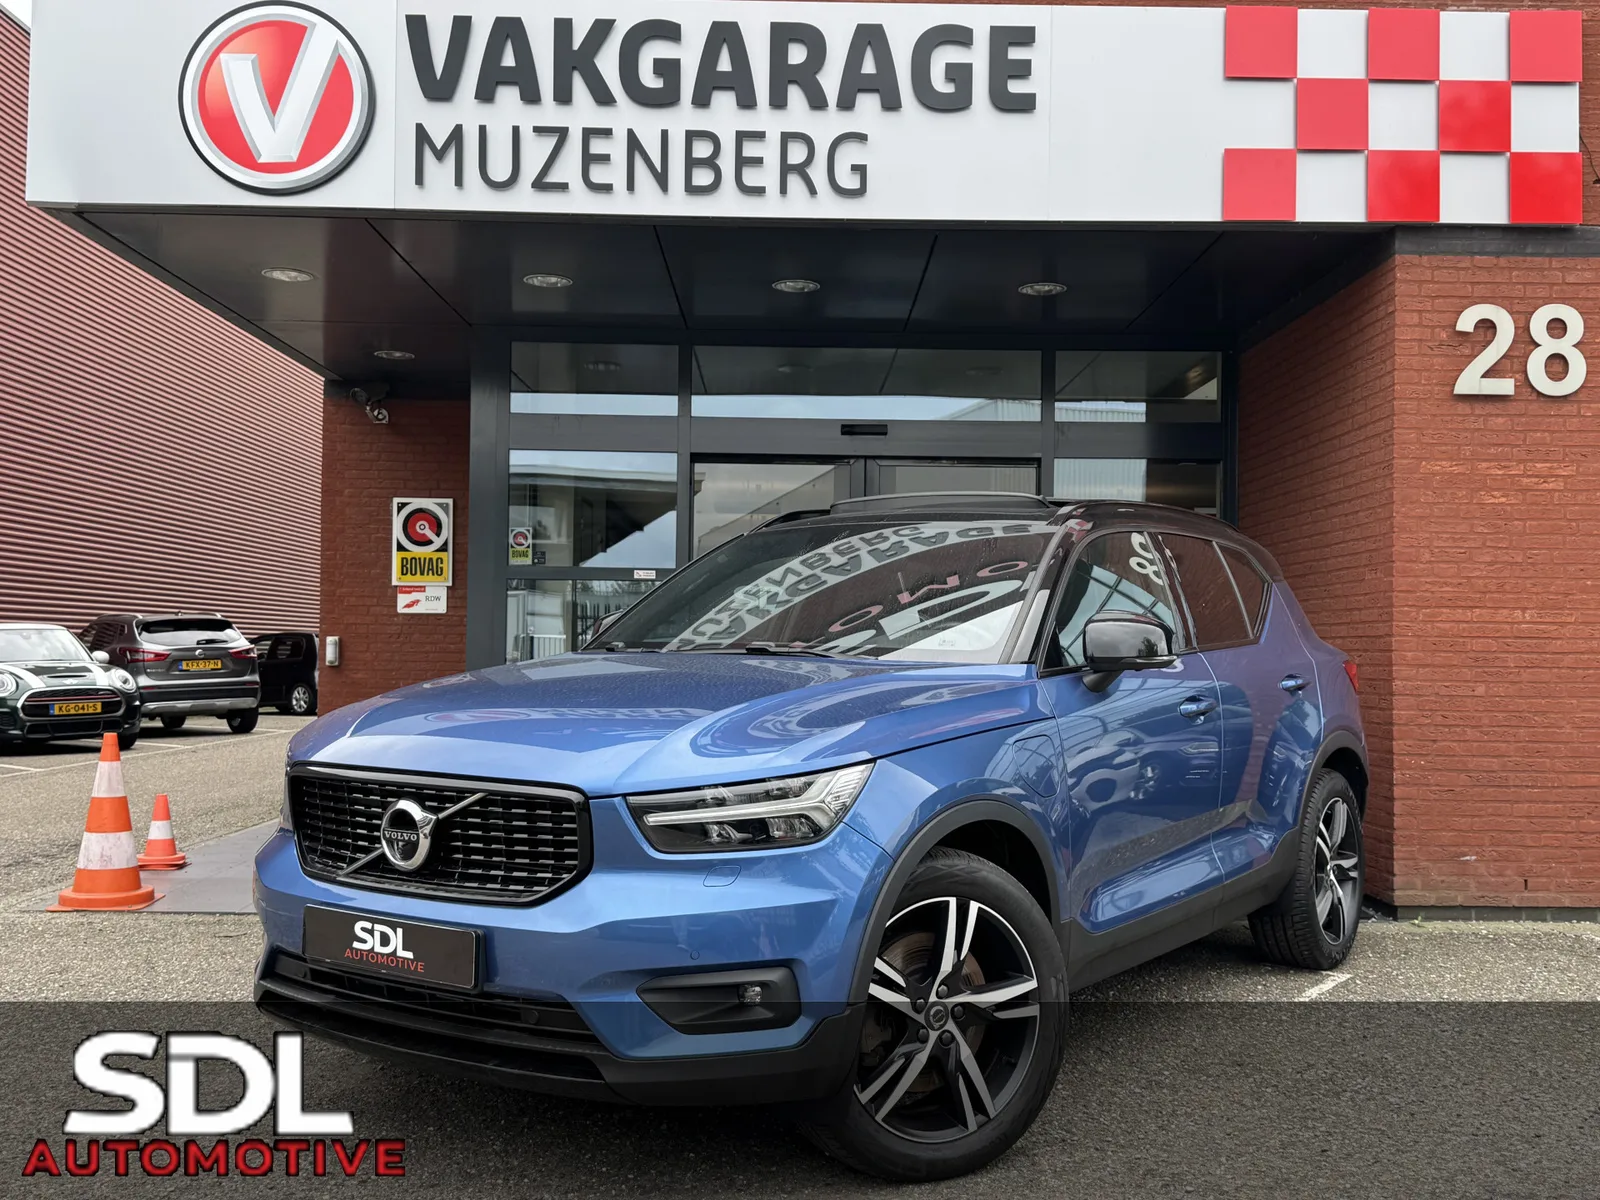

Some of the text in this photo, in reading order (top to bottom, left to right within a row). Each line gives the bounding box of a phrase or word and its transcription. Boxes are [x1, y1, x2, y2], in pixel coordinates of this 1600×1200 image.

[405, 14, 1038, 114] VAKGARAGE
[414, 122, 870, 198] MUZENBERG
[1453, 303, 1588, 397] 28
[511, 550, 529, 558] BOVAG
[400, 557, 444, 576] BOVAG
[185, 660, 219, 669] KFX-37-N
[58, 703, 98, 713] KG-041-S
[384, 830, 417, 841] VOLVO
[352, 920, 414, 959] SDL
[344, 948, 425, 973] AUTOMOTIVE
